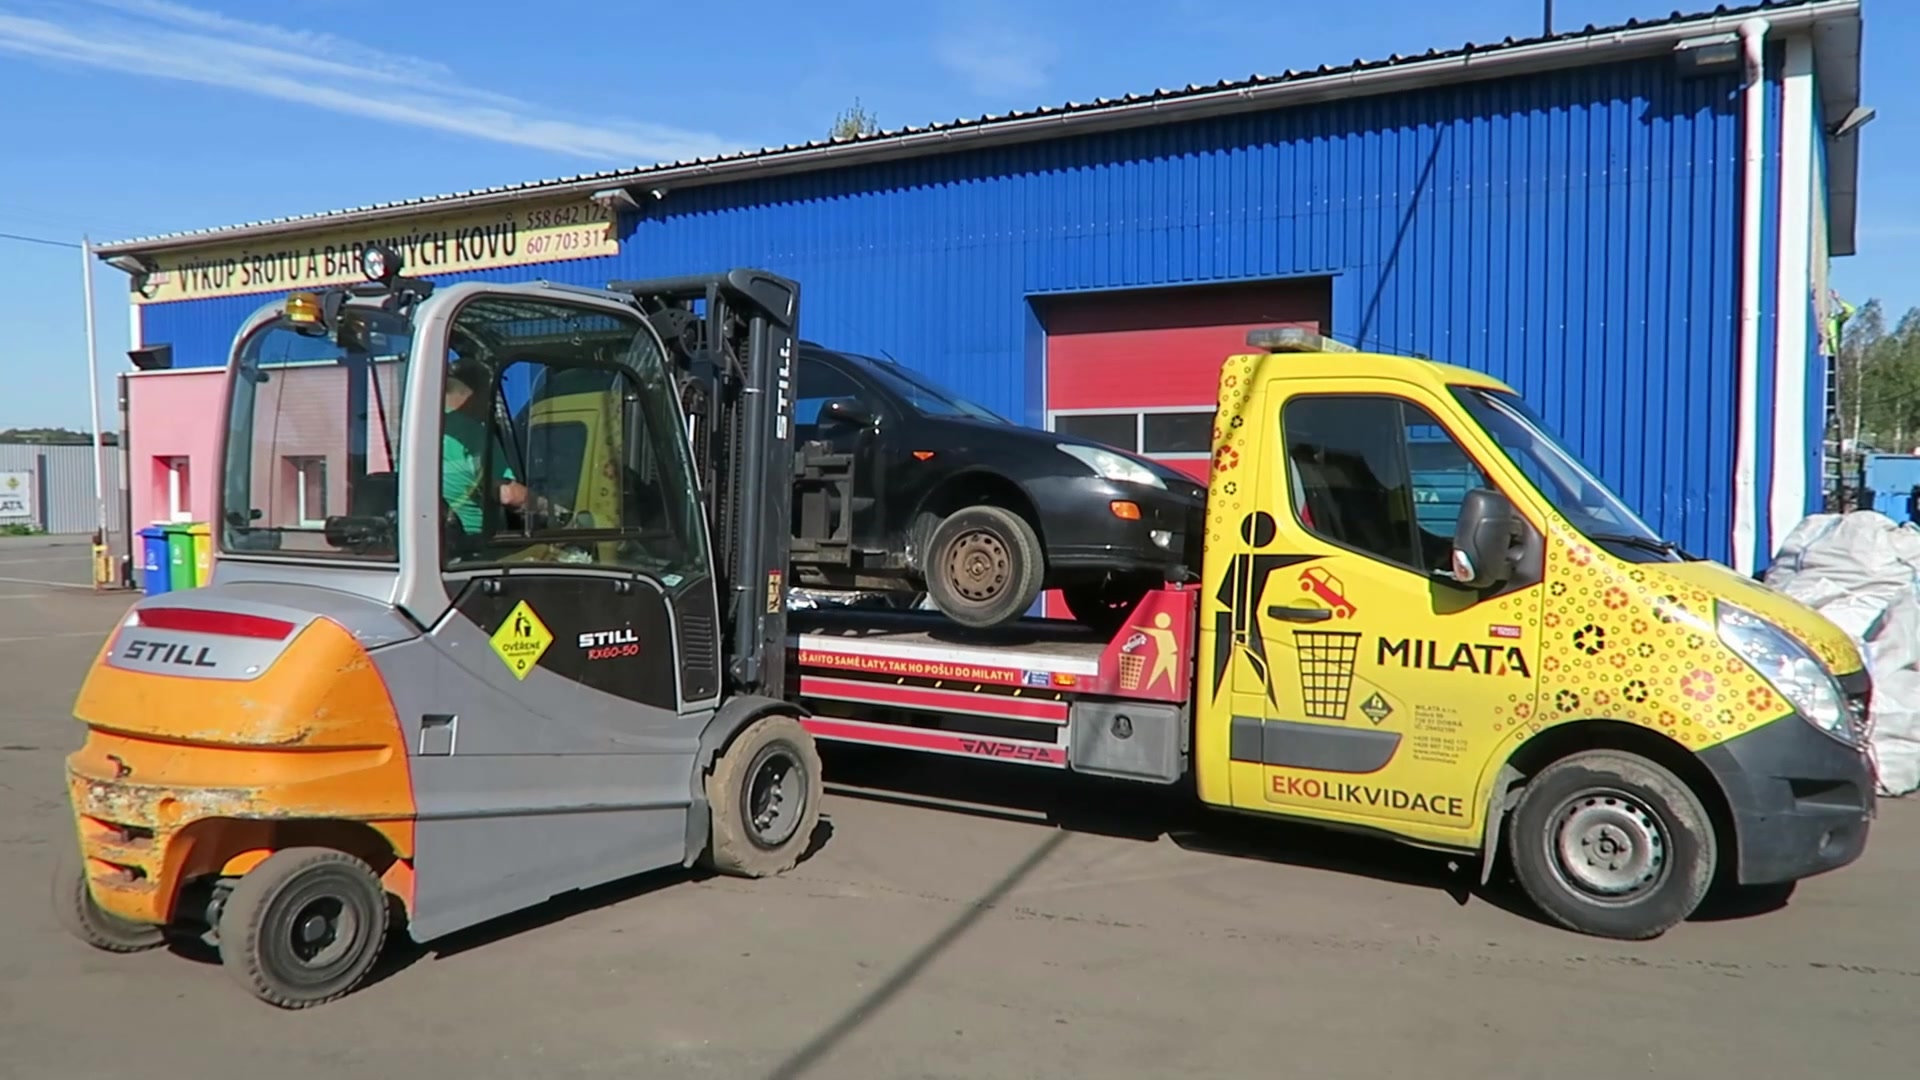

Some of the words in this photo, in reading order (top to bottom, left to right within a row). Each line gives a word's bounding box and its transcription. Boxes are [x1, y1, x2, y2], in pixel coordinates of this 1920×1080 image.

[526, 209, 551, 230] 558
[554, 206, 579, 225] 642
[178, 255, 236, 292] VÝKUP
[241, 250, 301, 286] ŠROTU
[306, 247, 318, 279] A
[324, 226, 447, 276] BARNÝCH
[455, 212, 517, 262] KOVŮ
[526, 235, 551, 254] 607
[555, 231, 579, 251] 703
[776, 337, 791, 440] STILL
[579, 629, 639, 647] STILL
[123, 640, 217, 668] STILL
[809, 654, 834, 664] AUTO
[888, 661, 907, 672] TAK
[908, 663, 923, 673] HO
[925, 664, 954, 675] POŠLI
[955, 667, 970, 677] DO
[1377, 636, 1532, 678] MILATA
[1272, 774, 1464, 818] EKOLIKVIDACE
